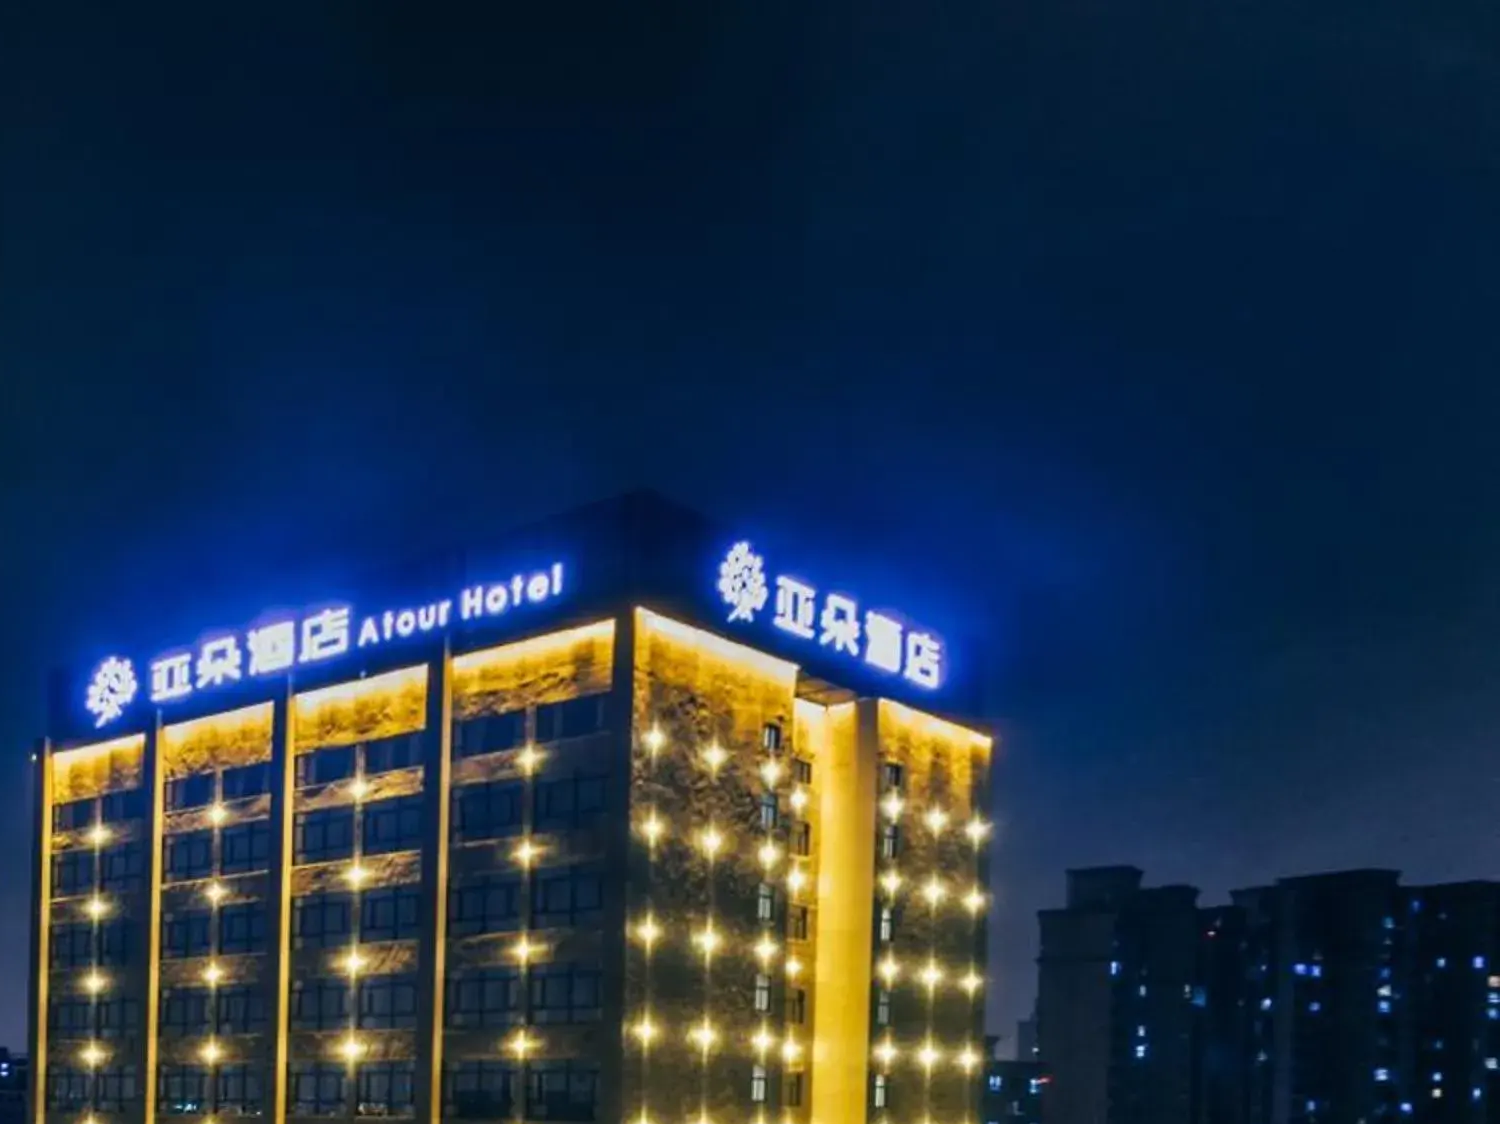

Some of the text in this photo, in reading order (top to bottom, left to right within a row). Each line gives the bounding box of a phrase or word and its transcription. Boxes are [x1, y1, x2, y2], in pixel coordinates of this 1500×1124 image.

[357, 562, 563, 647] Atour Hotel
[151, 608, 349, 701] 亚朵酒店
